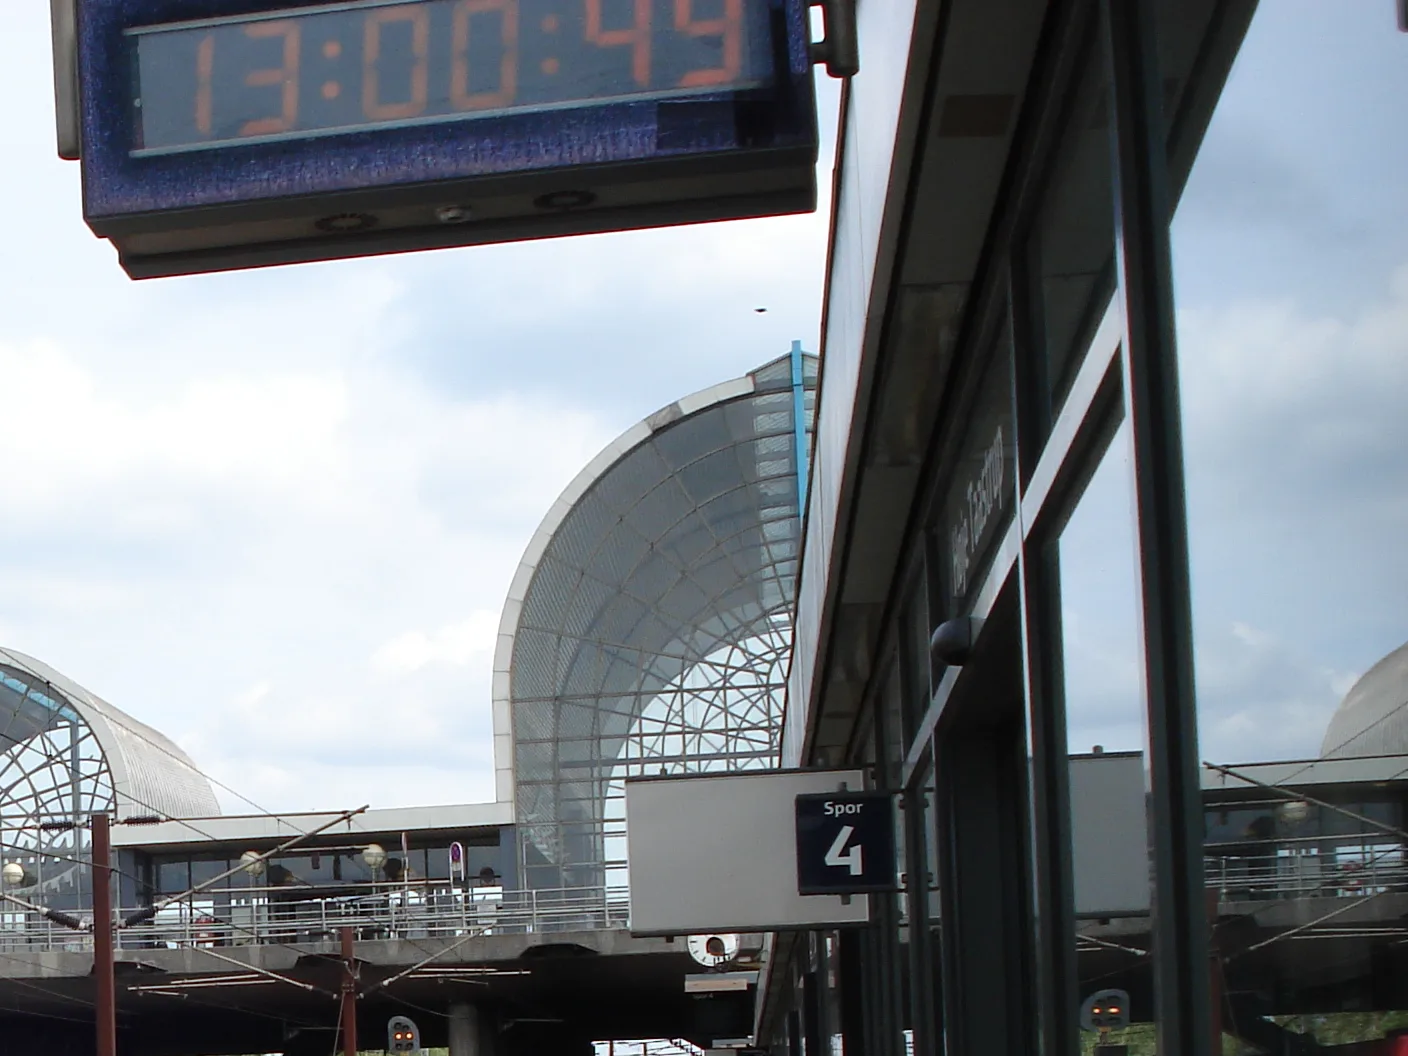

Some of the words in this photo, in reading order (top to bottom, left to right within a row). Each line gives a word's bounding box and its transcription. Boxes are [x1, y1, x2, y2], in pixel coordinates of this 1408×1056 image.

[195, 0, 741, 137] 13:00:49
[824, 801, 863, 818] Spor
[824, 825, 863, 876] 4
